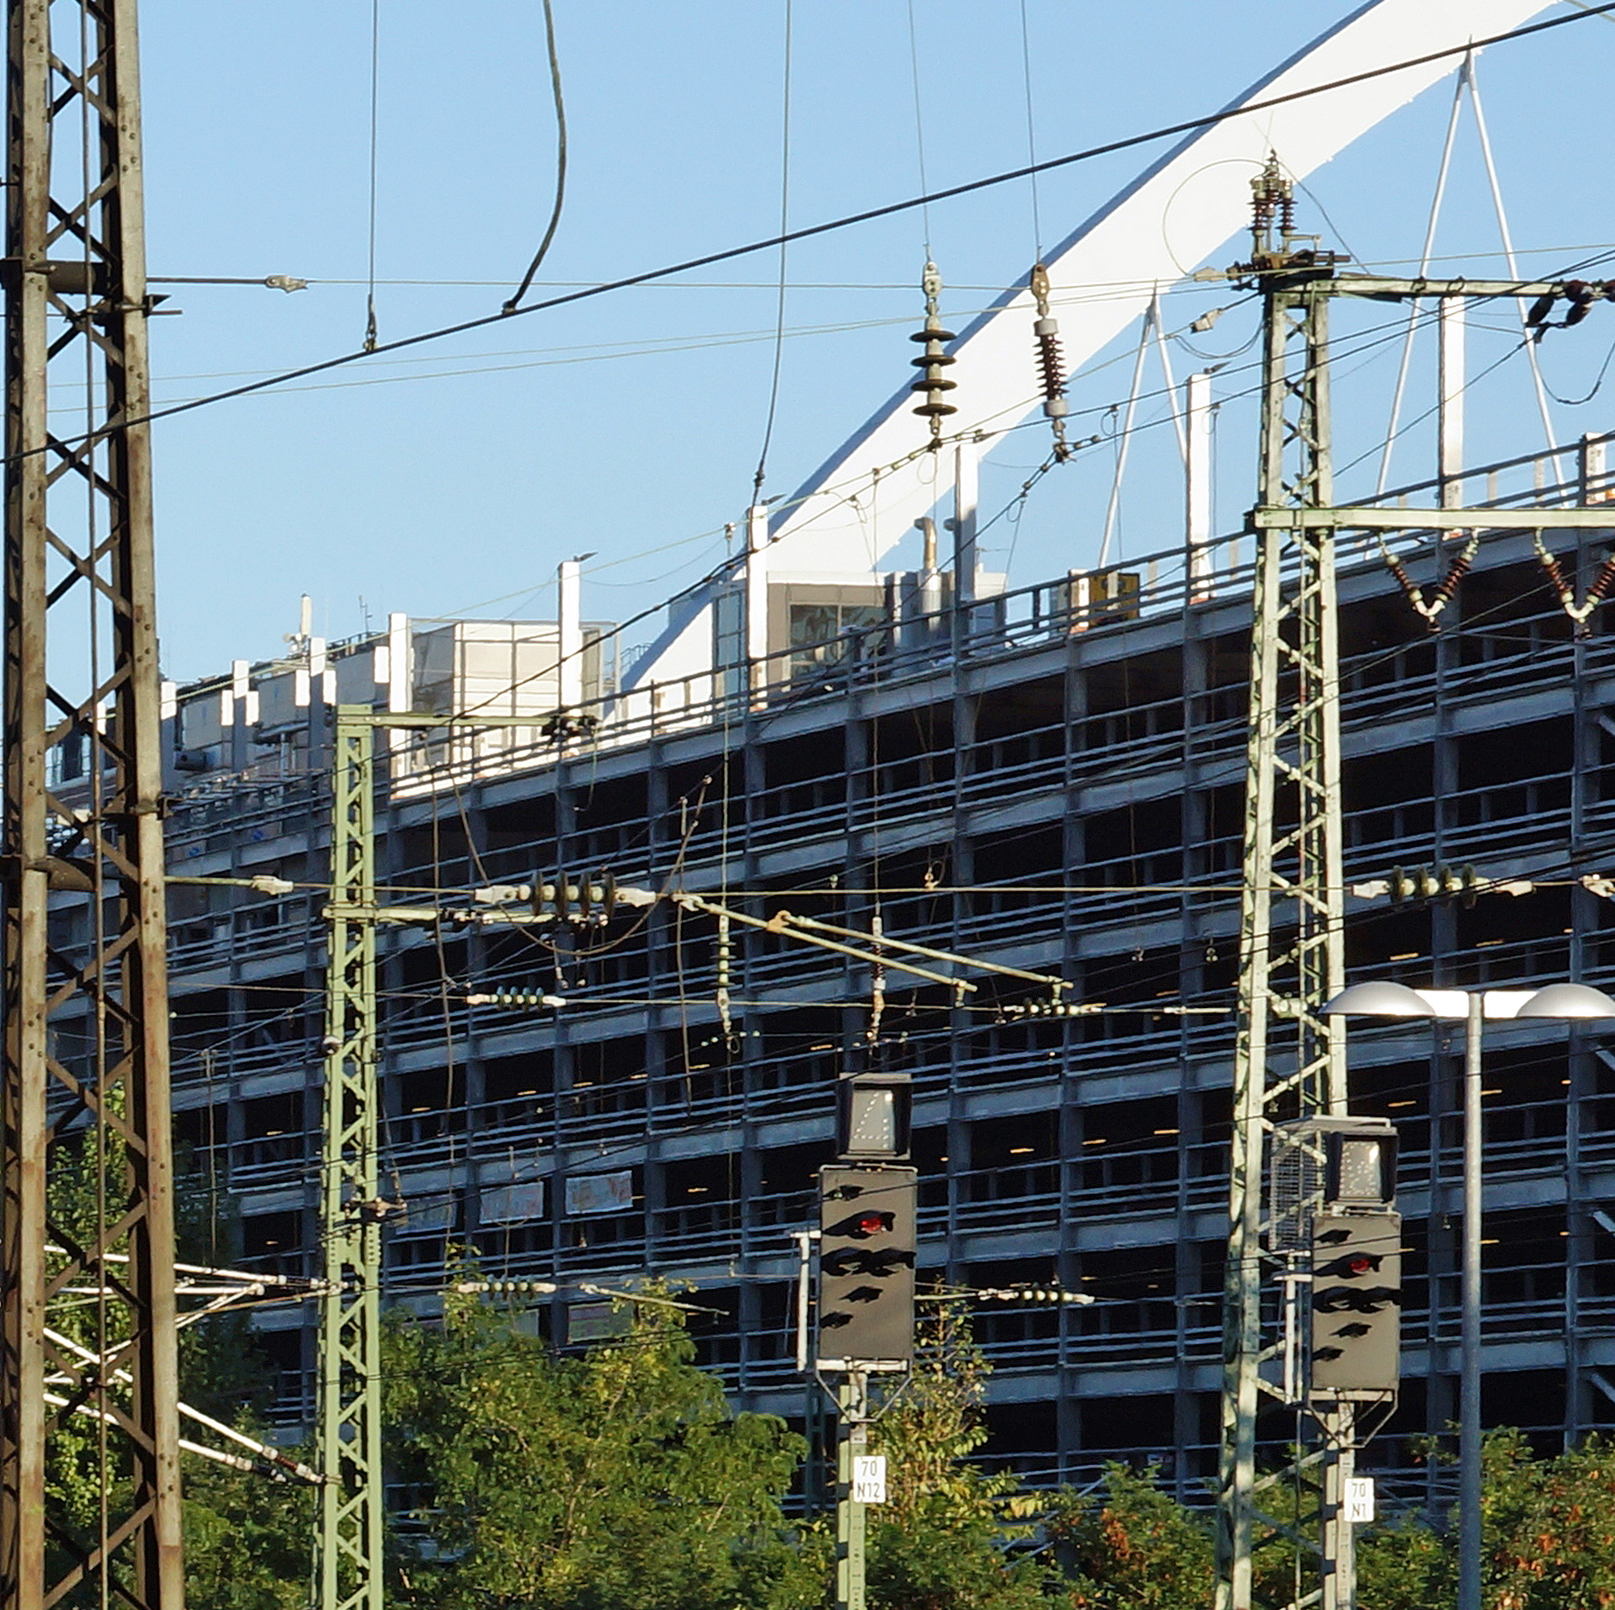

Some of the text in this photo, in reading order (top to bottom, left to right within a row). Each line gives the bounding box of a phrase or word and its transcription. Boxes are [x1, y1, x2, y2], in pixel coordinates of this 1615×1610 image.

[861, 1460, 878, 1477] 70
[856, 1482, 881, 1499] N12
[1351, 1482, 1367, 1498] 70
[1351, 1502, 1367, 1519] N1
